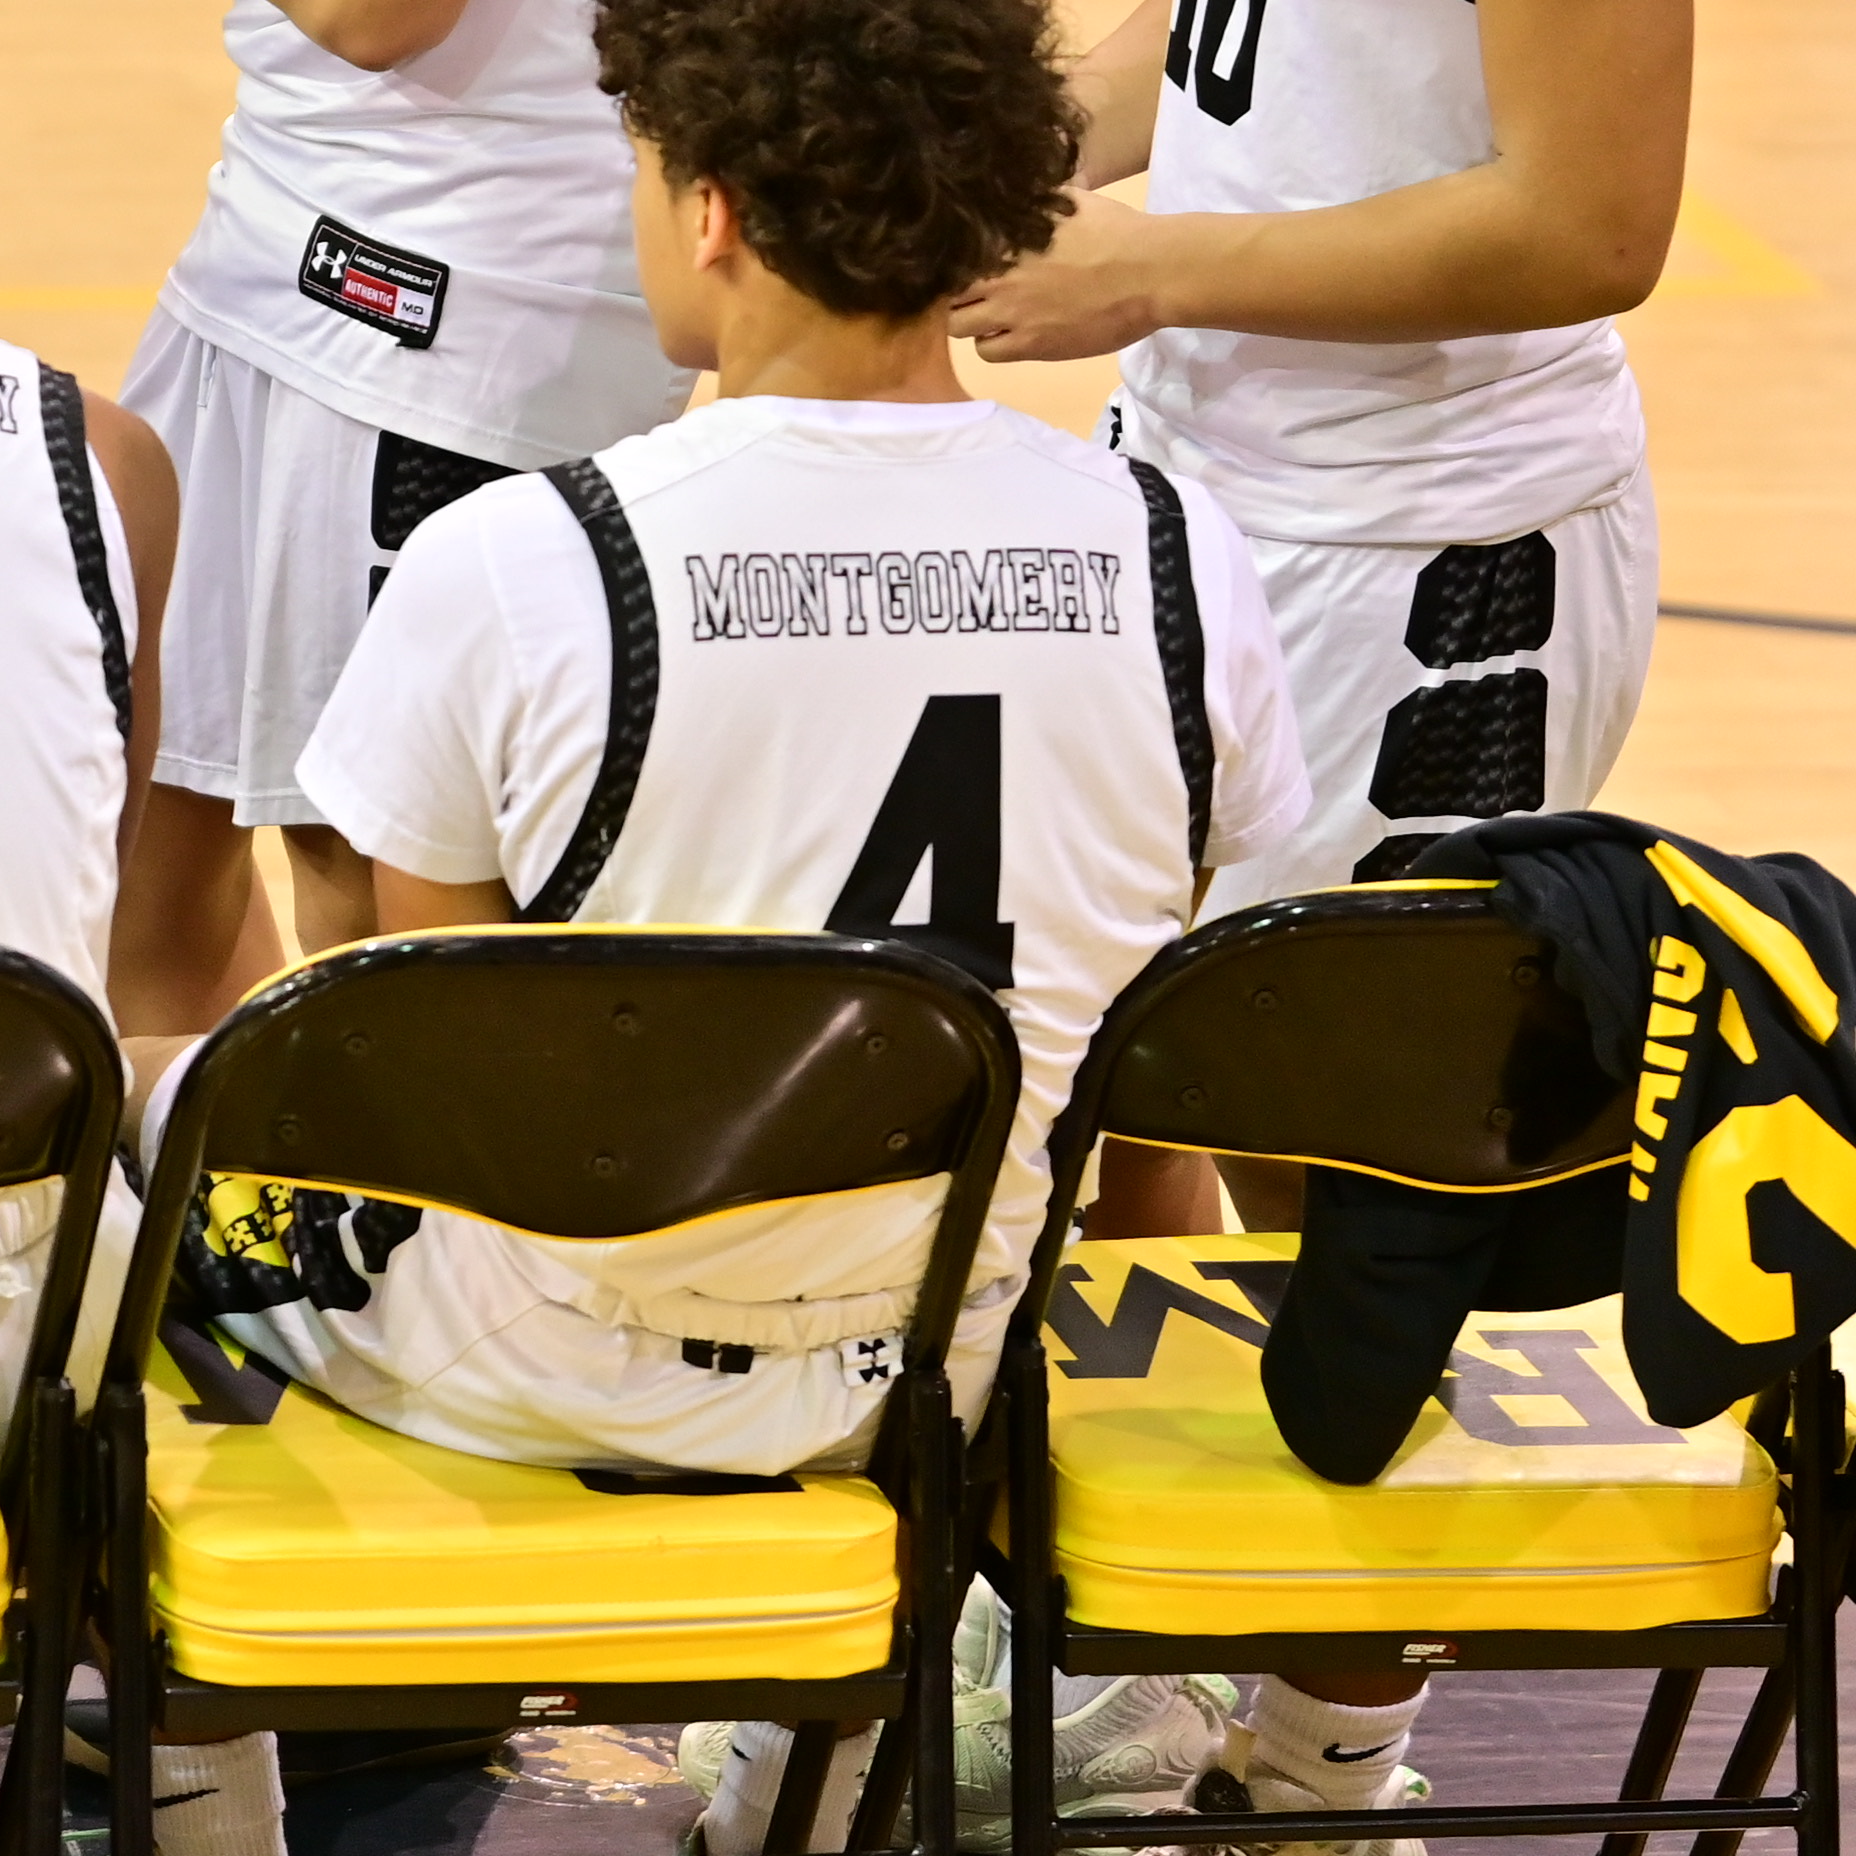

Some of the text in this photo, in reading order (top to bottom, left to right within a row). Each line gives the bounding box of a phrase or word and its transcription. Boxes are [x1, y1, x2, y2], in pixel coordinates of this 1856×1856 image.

[354, 253, 433, 288] UNDER ARMOUR
[345, 278, 394, 308] AUTHENTIC
[401, 301, 424, 315] MD
[685, 548, 1120, 641] MONTGOMERY
[823, 694, 1016, 989] 4
